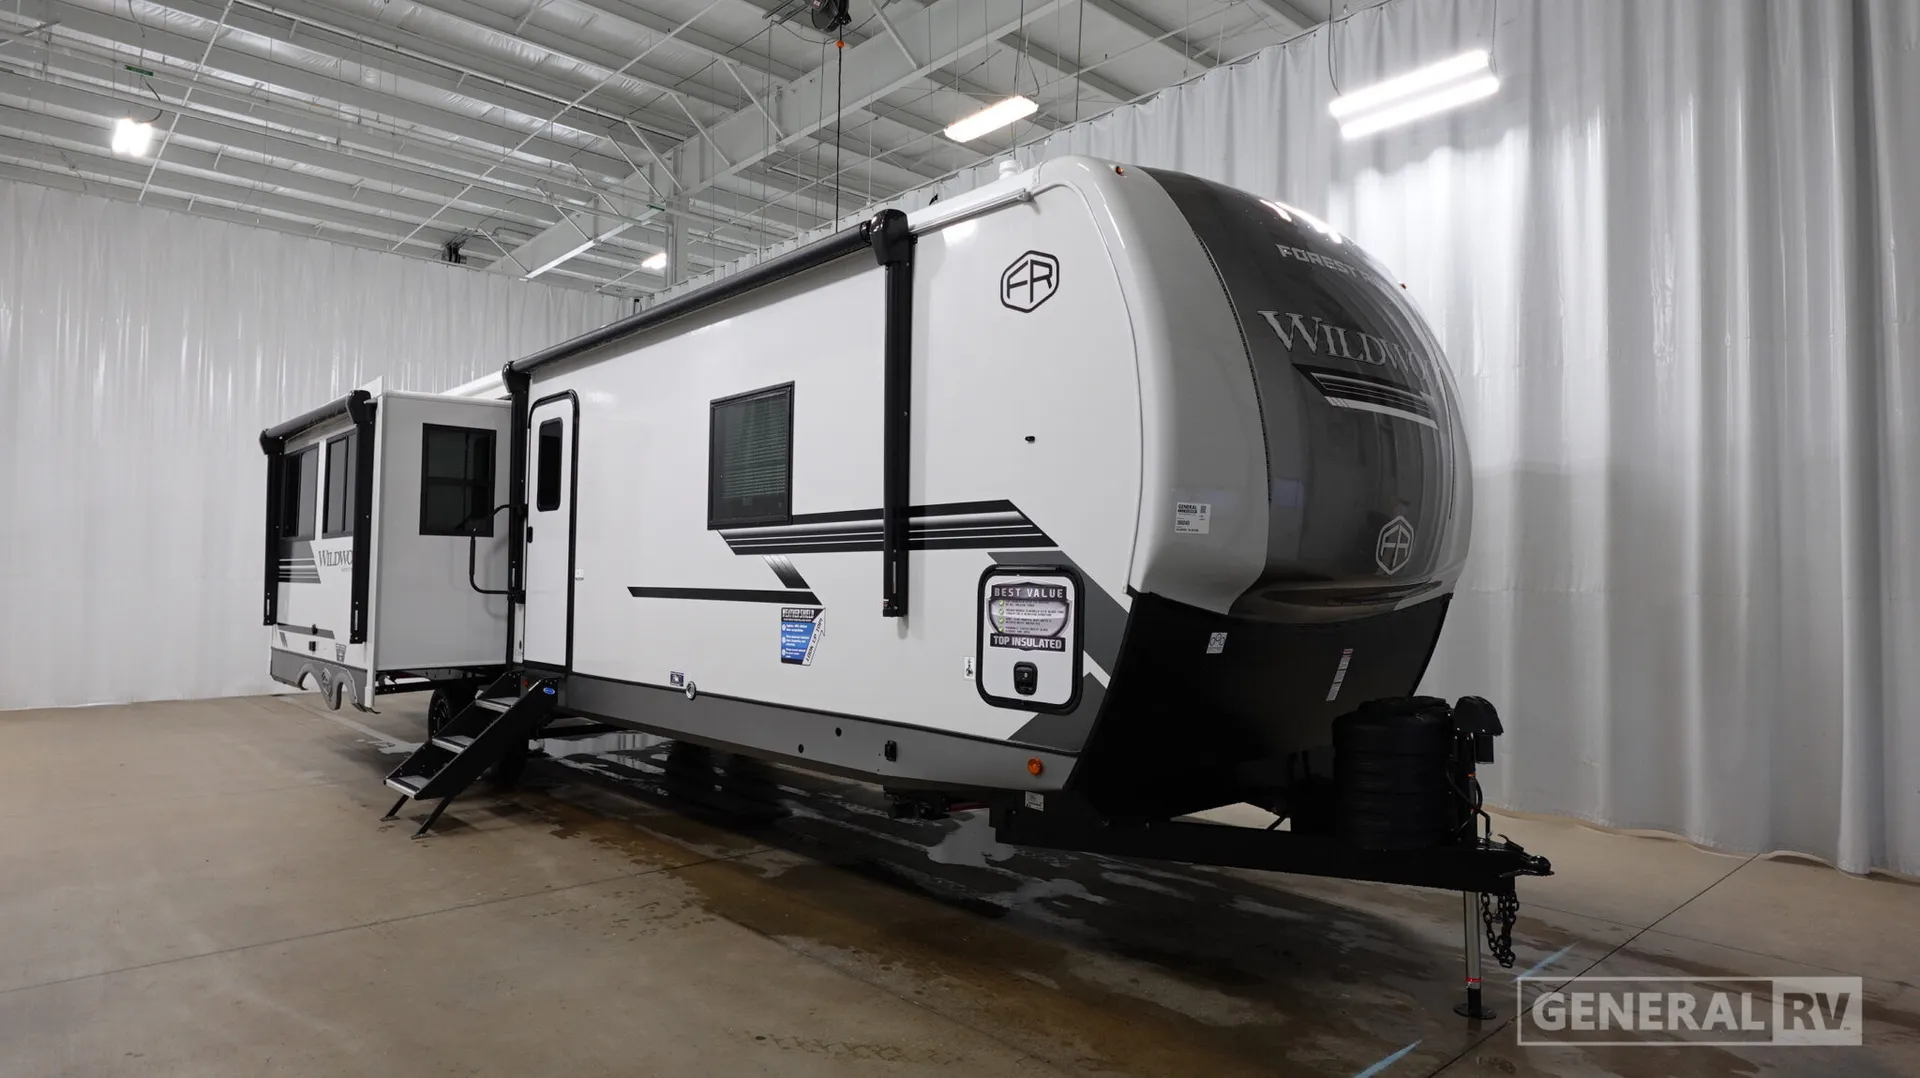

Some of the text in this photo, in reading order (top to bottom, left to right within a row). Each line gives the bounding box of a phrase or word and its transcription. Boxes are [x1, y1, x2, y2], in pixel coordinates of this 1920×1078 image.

[1274, 243, 1357, 278] FOREST
[1257, 310, 1430, 382] WILDWO
[318, 549, 353, 567] WILDWO
[994, 587, 1063, 599] BEST VALUE
[993, 635, 1062, 650] TOP INSULATED
